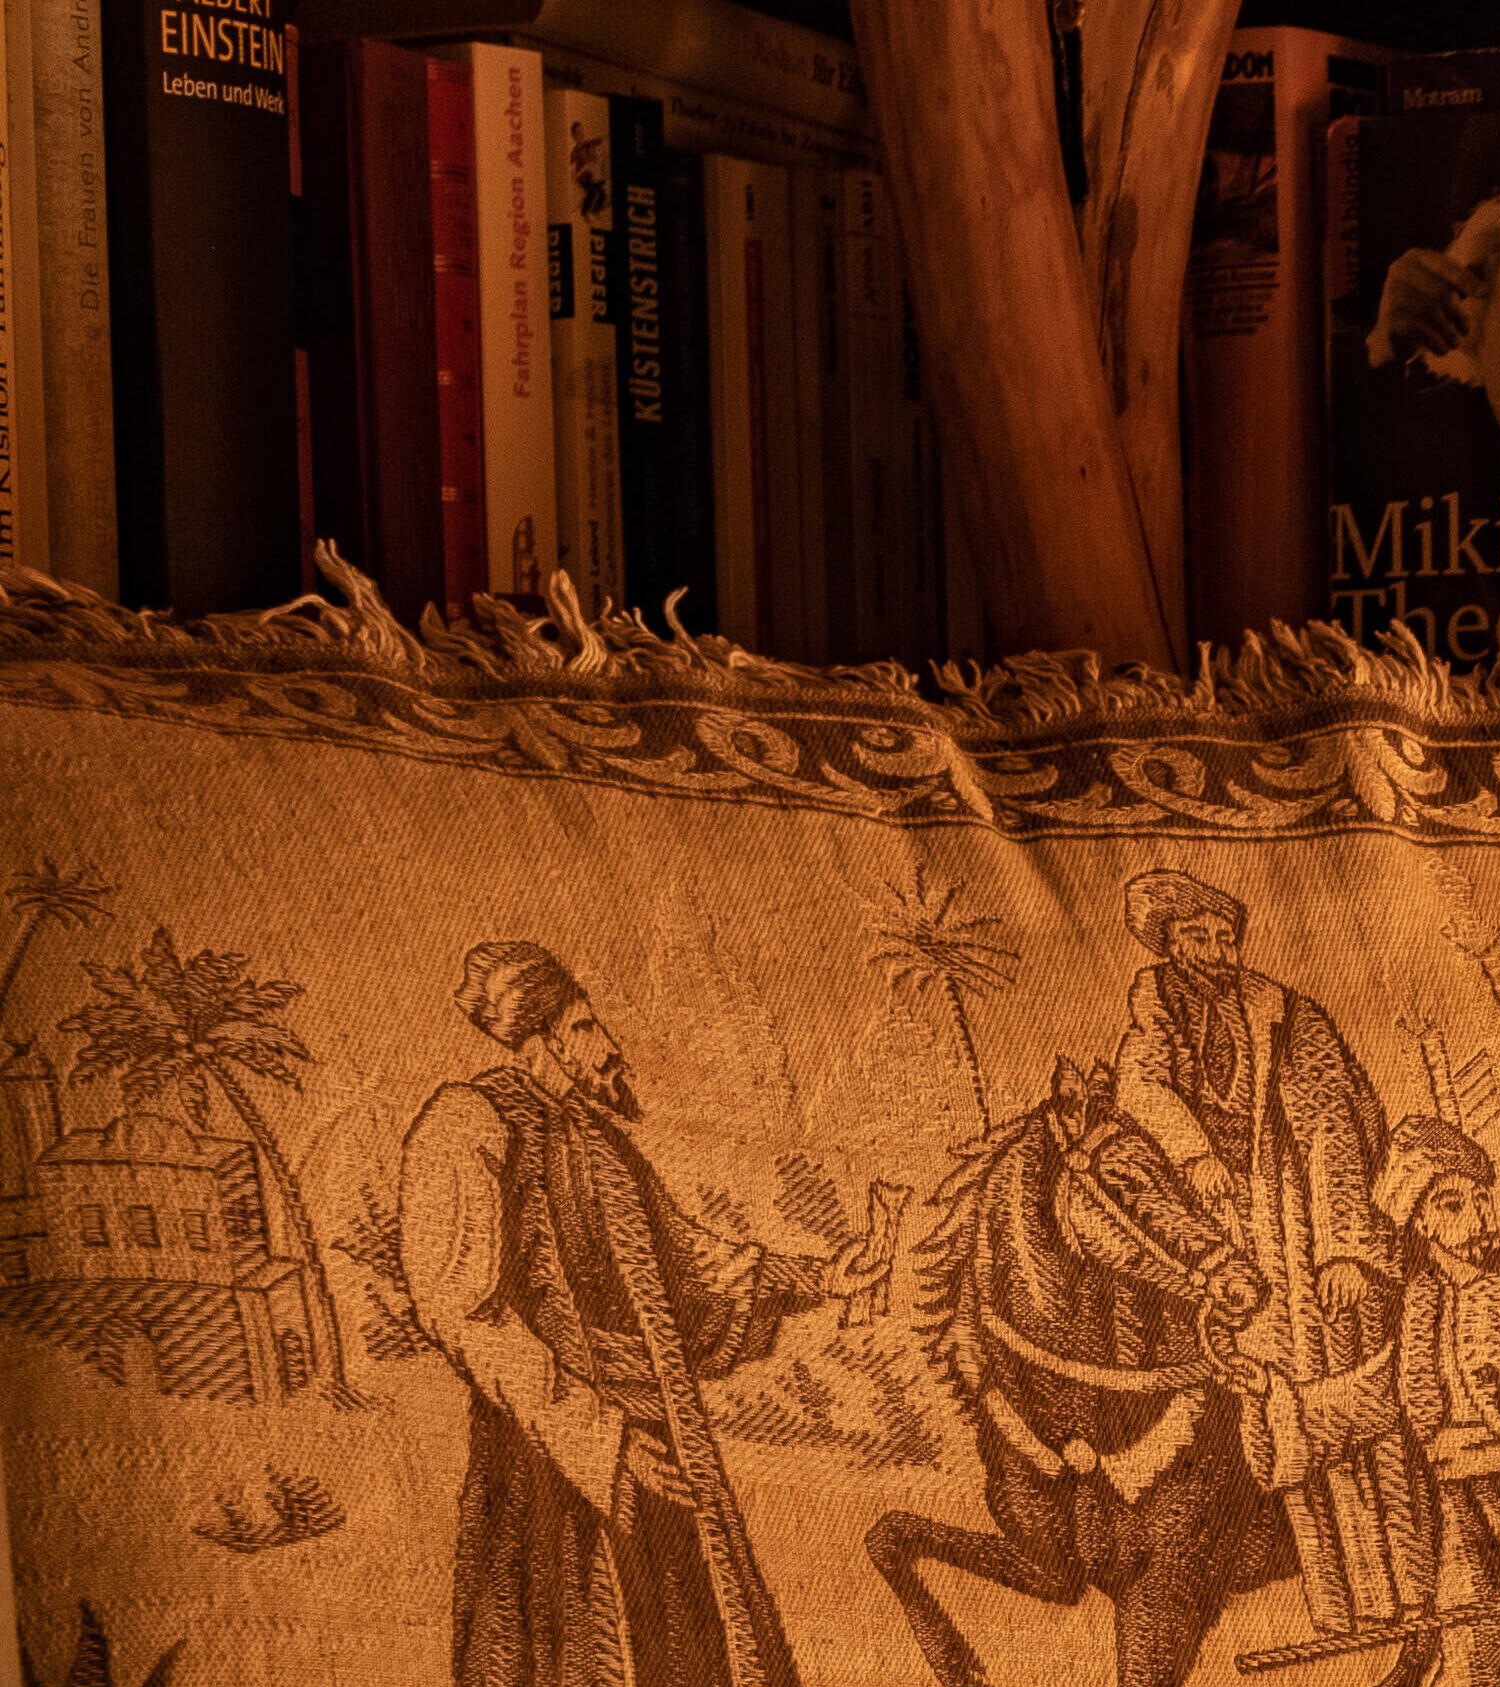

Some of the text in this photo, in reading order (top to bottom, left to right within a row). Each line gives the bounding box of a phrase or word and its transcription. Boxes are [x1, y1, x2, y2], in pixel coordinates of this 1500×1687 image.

[160, 8, 285, 77] EINSTEIN
[162, 70, 218, 101] Leben
[222, 82, 253, 108] und
[503, 65, 534, 398] Fahrplan Region Aachen
[624, 183, 663, 422] KÜSTENSTRICH
